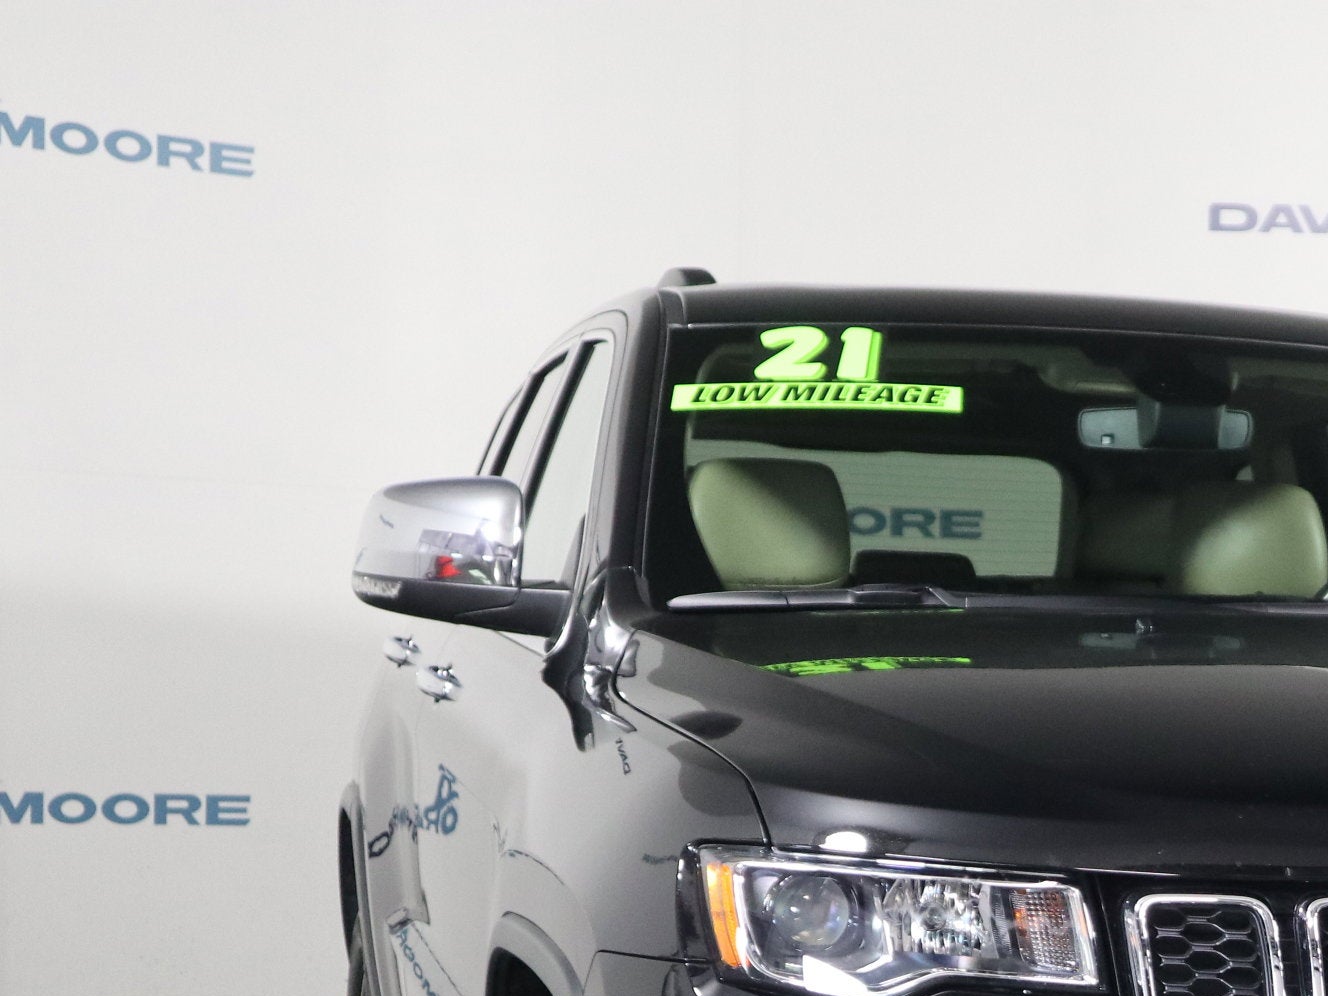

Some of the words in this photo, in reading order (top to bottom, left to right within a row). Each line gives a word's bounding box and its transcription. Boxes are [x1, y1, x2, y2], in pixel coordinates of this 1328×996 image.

[753, 326, 882, 382] 21
[690, 384, 774, 404] LOW
[779, 384, 946, 406] MILEAGE
[848, 506, 983, 540] ORE
